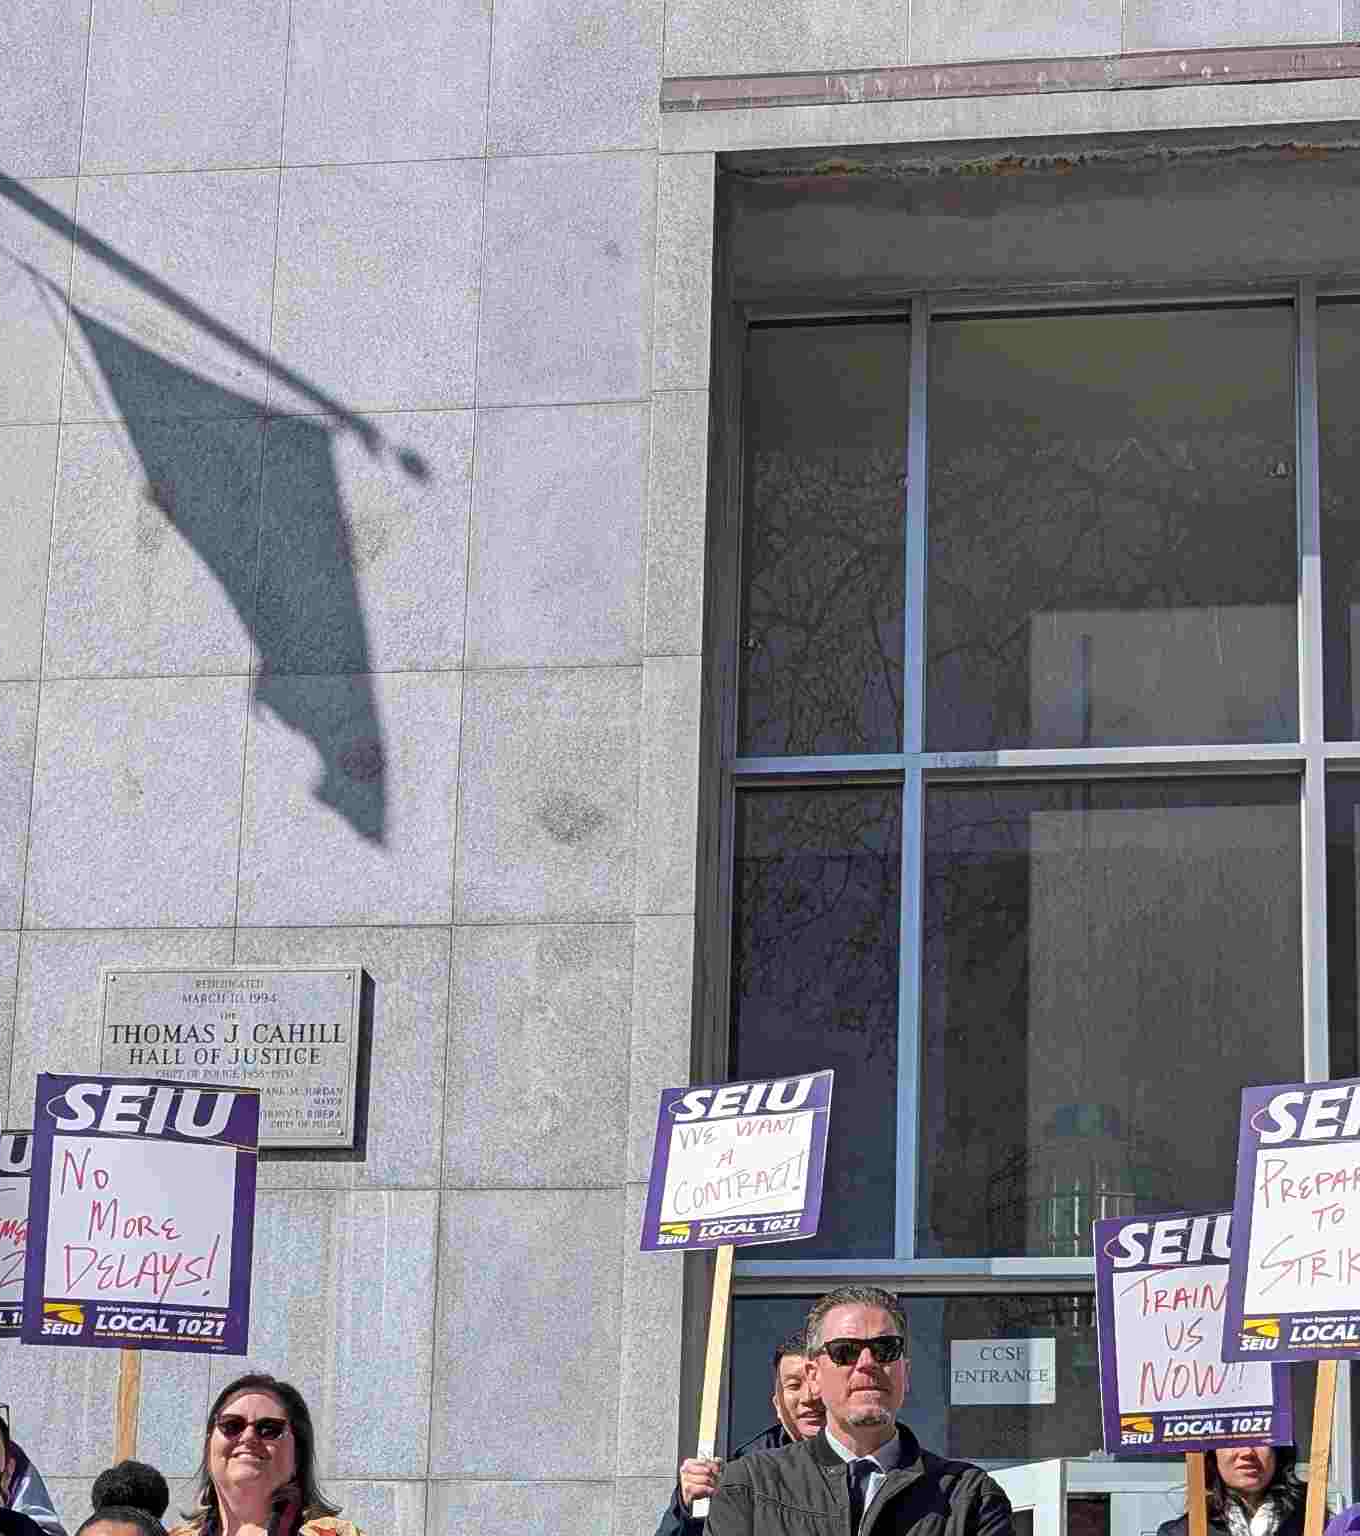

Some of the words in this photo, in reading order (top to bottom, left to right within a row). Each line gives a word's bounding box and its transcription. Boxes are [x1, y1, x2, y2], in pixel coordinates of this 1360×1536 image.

[110, 1023, 216, 1044] THOMAS
[253, 1023, 346, 1044] CAHILL
[129, 1047, 186, 1067] HALL
[194, 1047, 221, 1066] OF
[231, 1047, 321, 1065] JUSTICE
[55, 1083, 235, 1137] SEIU
[674, 1077, 814, 1122] SEIU
[679, 1126, 720, 1150] WE
[736, 1117, 796, 1138] WANT
[717, 1149, 735, 1168] A
[673, 1149, 807, 1217] CONTRACT!
[88, 1198, 183, 1241] MORE
[698, 1219, 757, 1239] LOCAL
[762, 1216, 801, 1232] 1021
[1312, 1202, 1346, 1233] TO
[63, 1233, 221, 1306] DELAYS!
[40, 1323, 84, 1336] SEIU
[95, 1313, 169, 1333] LOCAL
[176, 1318, 226, 1337] 1021
[1164, 1316, 1205, 1354] US
[1289, 1323, 1360, 1343] LOCAL
[979, 1345, 1025, 1361] CCSF
[1240, 1337, 1280, 1352] SEIU
[952, 1367, 1049, 1384] ENTRANCE
[1163, 1419, 1226, 1438] LOCAL
[1231, 1416, 1273, 1433] 1021
[1120, 1433, 1154, 1446] SEIU
